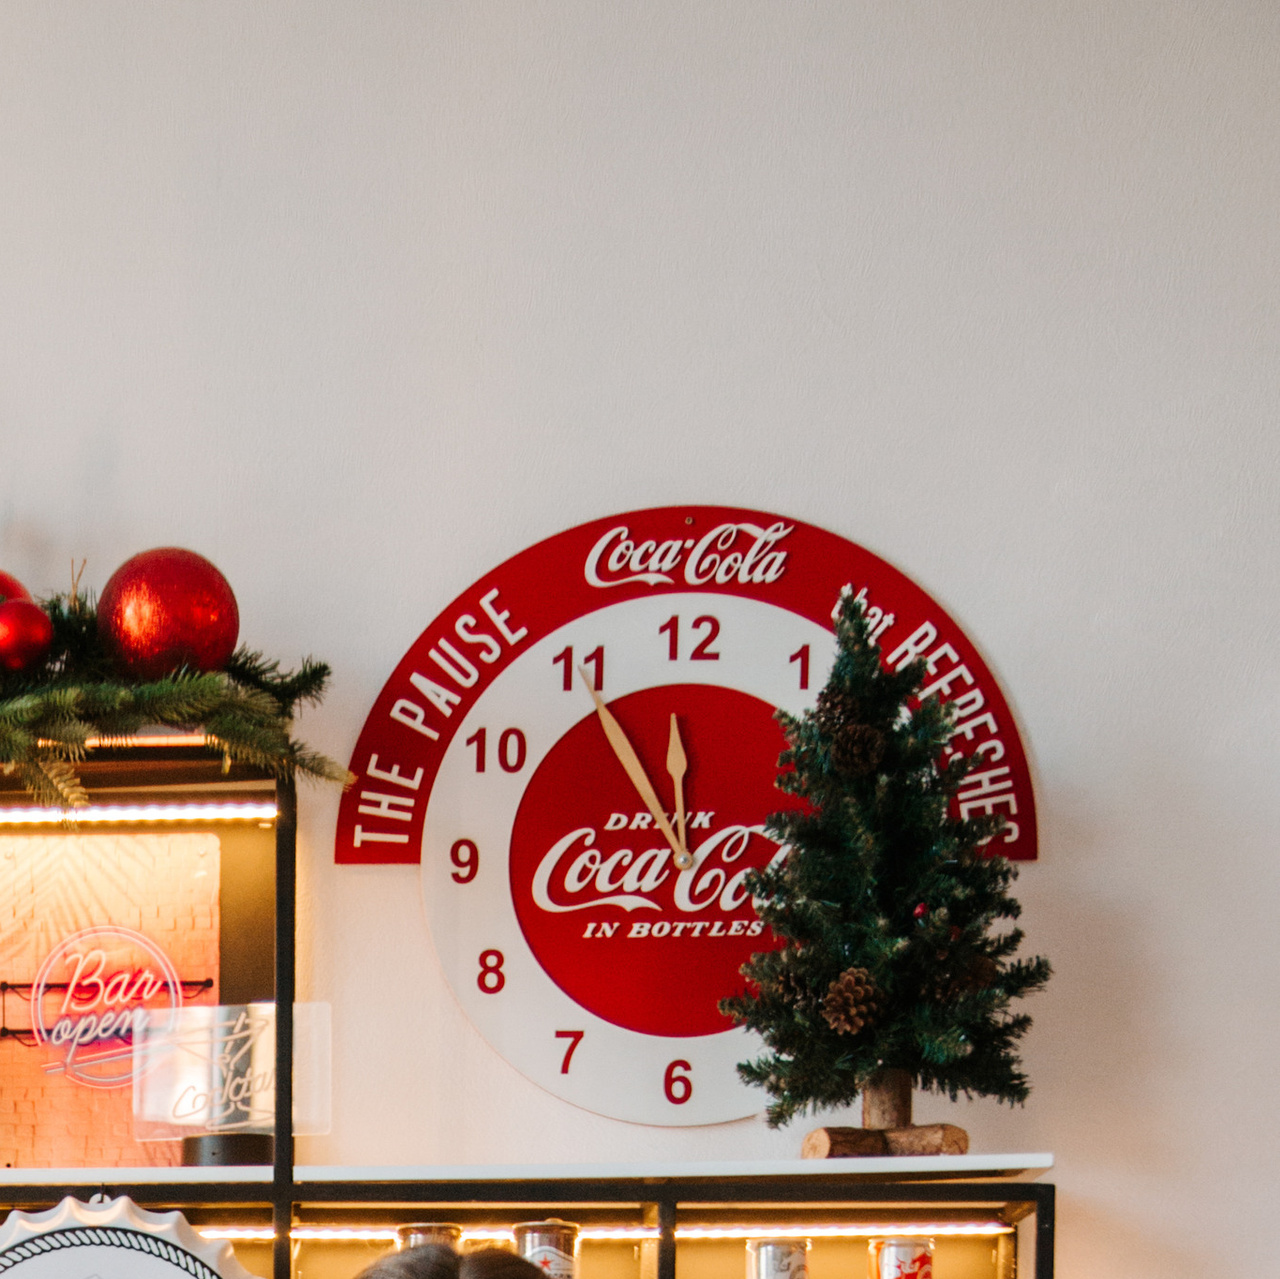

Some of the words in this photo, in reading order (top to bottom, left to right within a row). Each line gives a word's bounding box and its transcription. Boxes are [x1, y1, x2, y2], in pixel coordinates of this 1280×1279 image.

[584, 521, 794, 588] Coca-Cola
[658, 615, 720, 660] 12
[552, 645, 605, 691] 11
[788, 644, 811, 690] 1
[353, 752, 424, 848] THE
[389, 586, 528, 742] PAUSE
[466, 726, 527, 774] 10
[449, 838, 479, 883] 9
[582, 921, 621, 939] IN
[626, 919, 764, 938] BOTTLES
[60, 949, 162, 1015] Bar
[477, 949, 506, 994] 8
[51, 1006, 150, 1062] open
[554, 1030, 584, 1074] 7
[663, 1059, 693, 1104] 6
